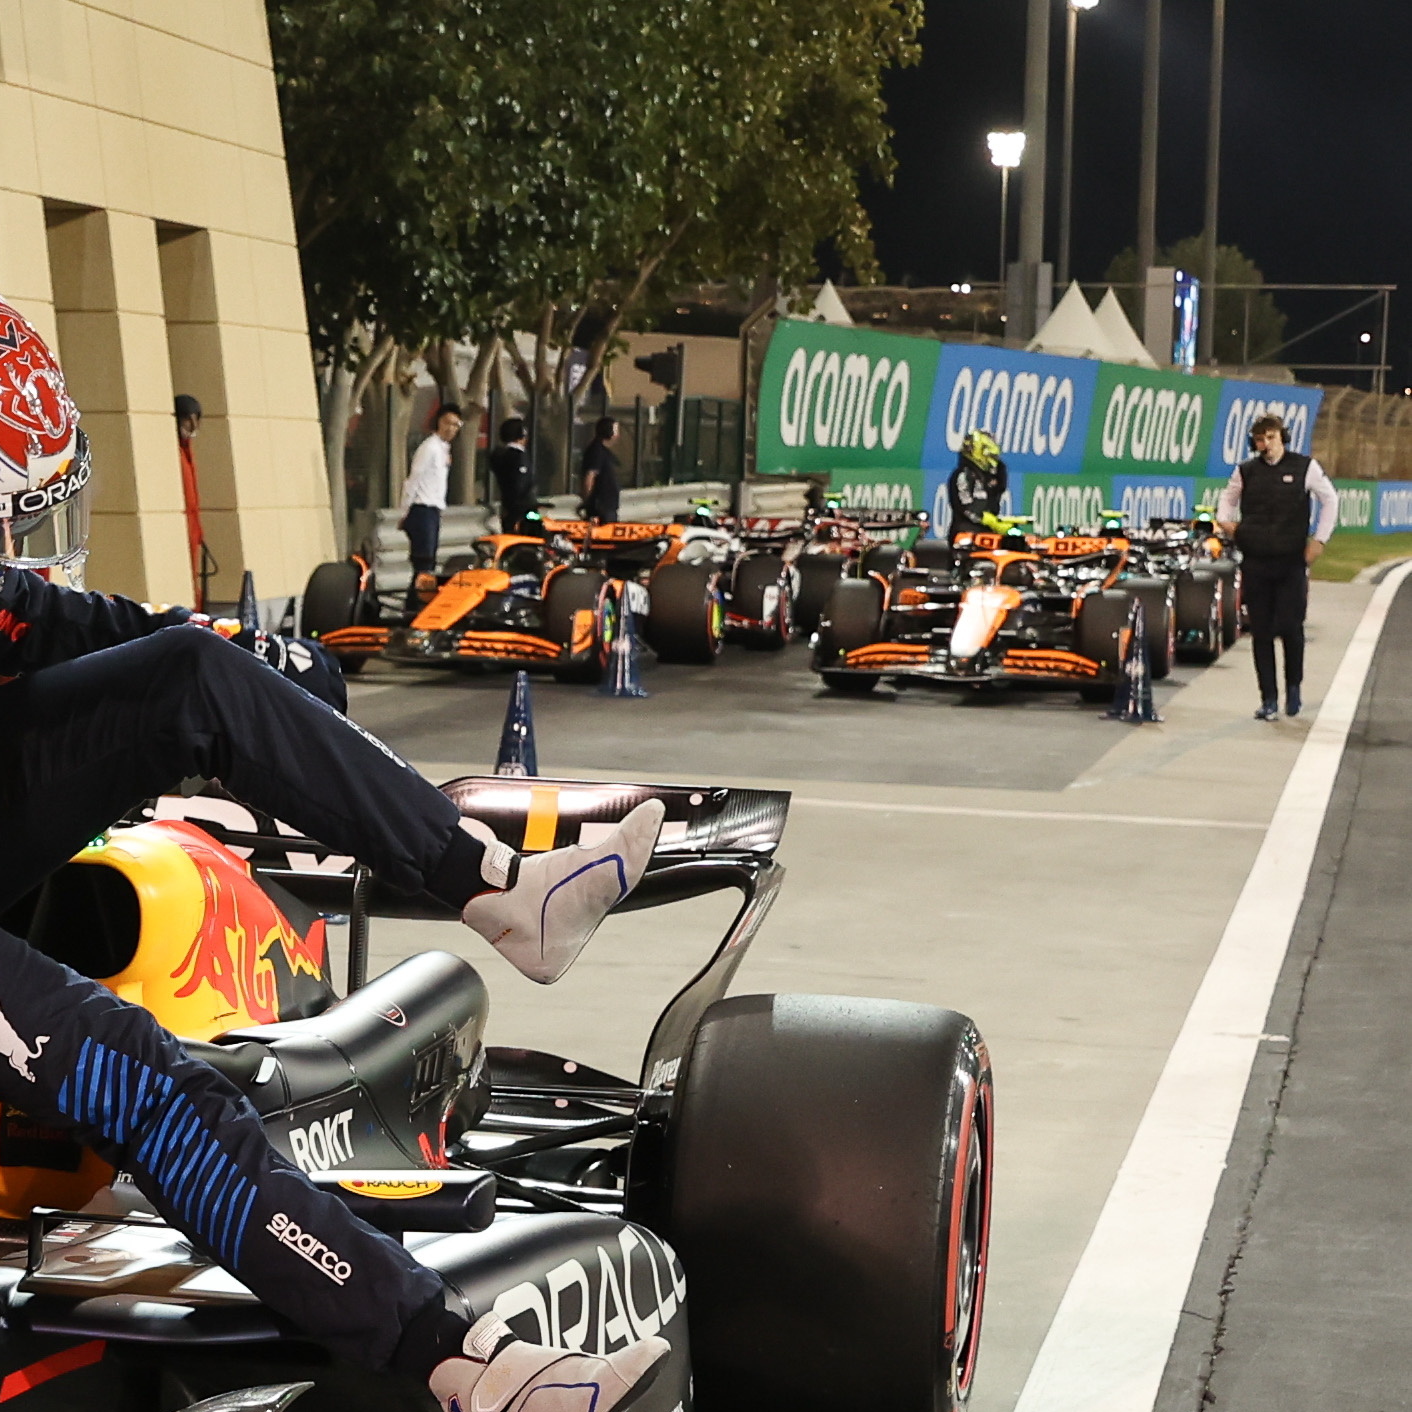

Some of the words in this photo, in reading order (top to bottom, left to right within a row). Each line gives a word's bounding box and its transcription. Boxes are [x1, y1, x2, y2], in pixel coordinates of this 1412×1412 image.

[780, 347, 910, 450] aramco
[946, 366, 1073, 456] aramco
[1101, 383, 1203, 464] aramco
[1222, 398, 1308, 465] arco
[289, 1108, 354, 1173] ROKT
[268, 1212, 352, 1284] sparco
